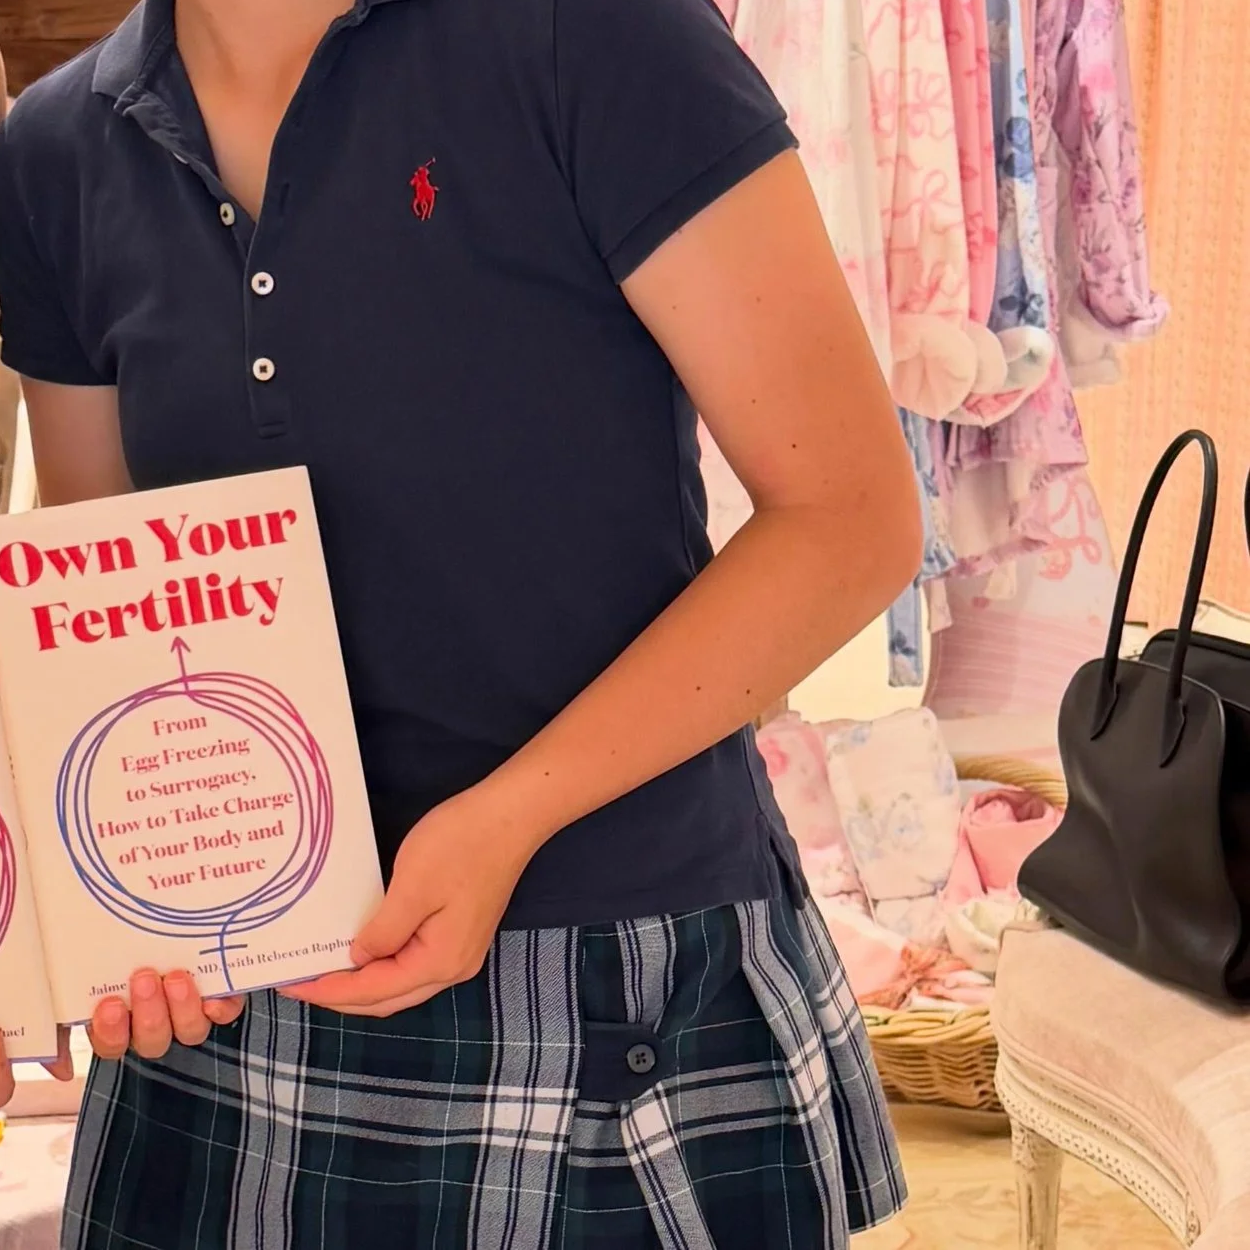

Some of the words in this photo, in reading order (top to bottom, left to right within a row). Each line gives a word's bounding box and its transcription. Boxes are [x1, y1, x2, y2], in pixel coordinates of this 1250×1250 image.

[145, 509, 297, 562] Your
[31, 573, 284, 651] Fertility
[153, 716, 207, 736] From
[121, 755, 160, 774] Egg
[163, 738, 250, 765] Freezing
[126, 786, 146, 802] to
[150, 769, 256, 798] Surrogacy,
[98, 819, 142, 838] How
[147, 812, 166, 830] to
[169, 804, 219, 825] Take
[224, 792, 294, 815] Charge
[118, 845, 140, 865] of
[140, 842, 189, 861] Your
[194, 829, 242, 851] Body
[248, 820, 285, 841] and
[148, 871, 195, 890] Your
[199, 858, 266, 880] Future
[89, 982, 127, 997] Jaime
[257, 947, 308, 965] Rebecca
[312, 938, 355, 953] Rapha
